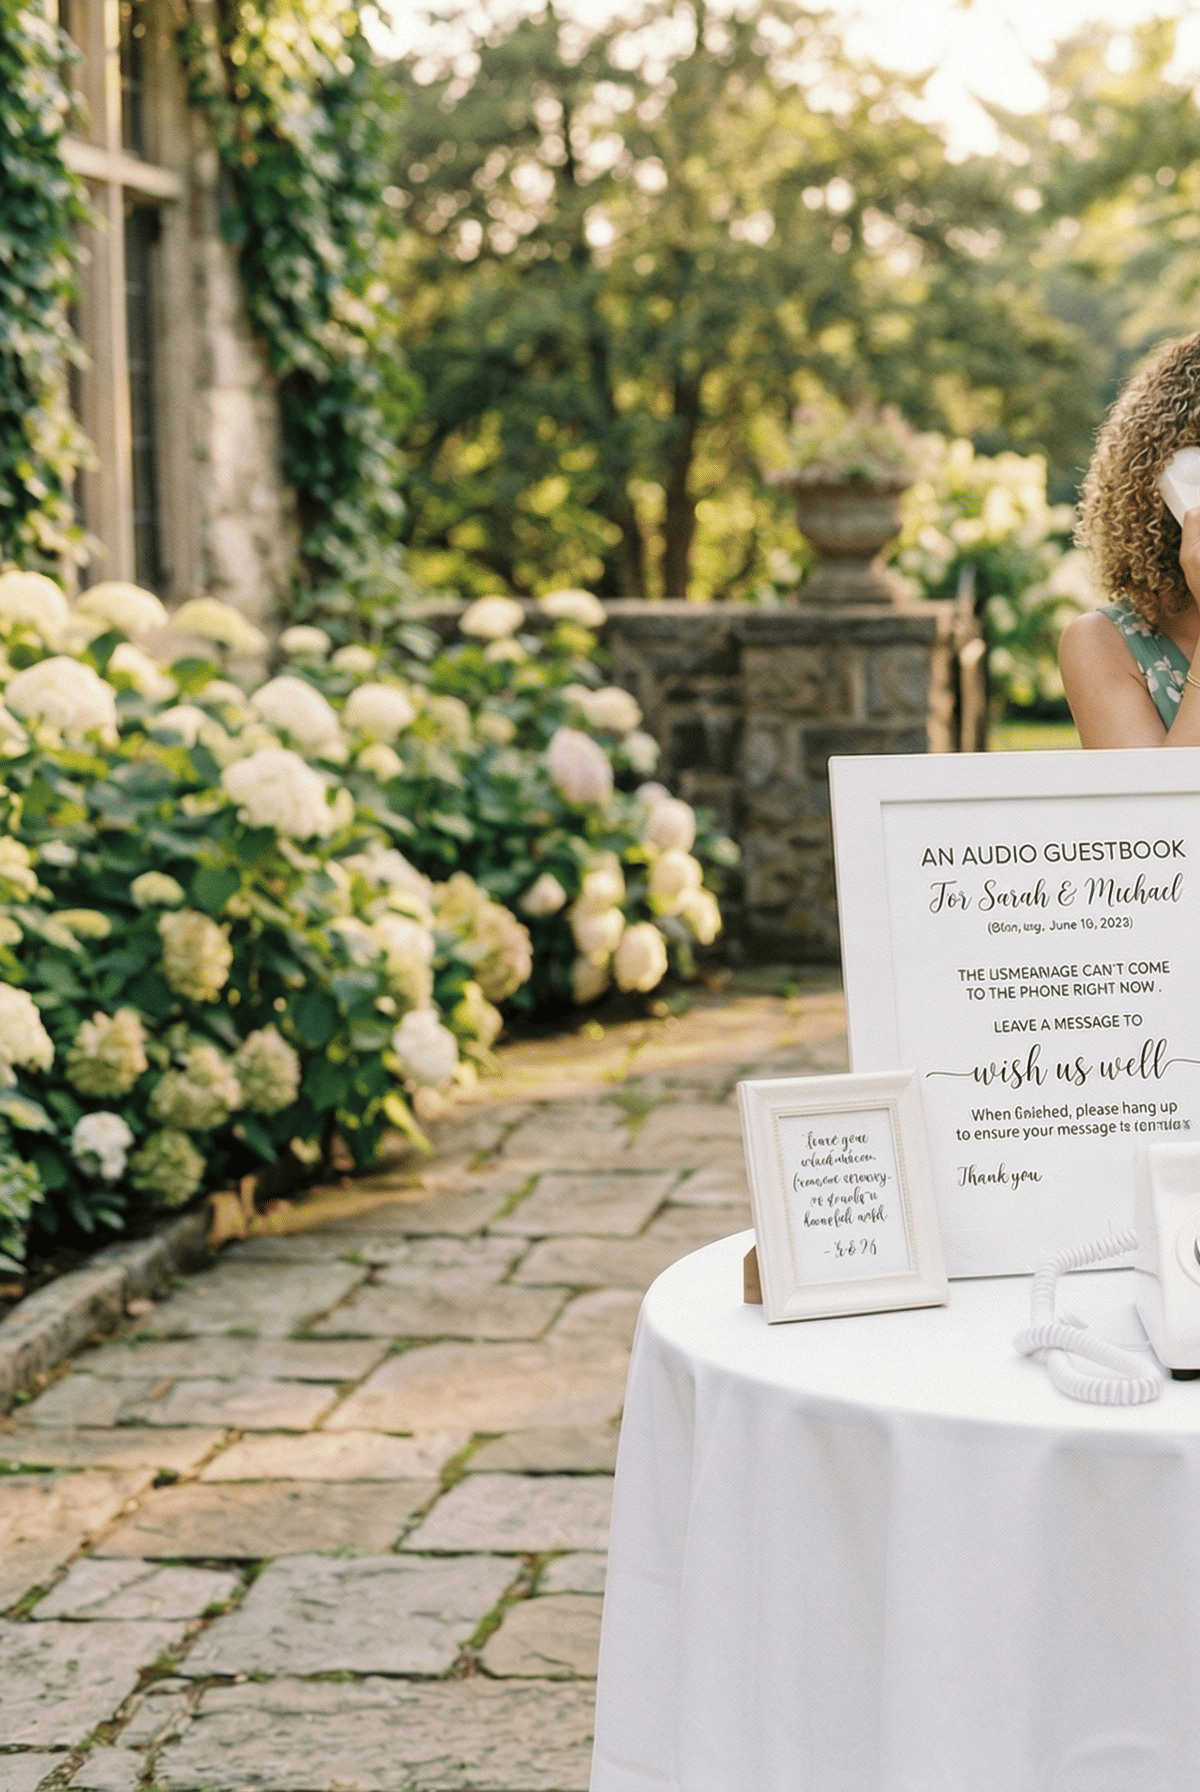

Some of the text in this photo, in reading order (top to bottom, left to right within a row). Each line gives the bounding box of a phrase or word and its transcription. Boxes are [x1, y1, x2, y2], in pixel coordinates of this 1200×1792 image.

[921, 839, 1186, 867] AN AUDIO GUESTBOOK
[978, 878, 1050, 912] Sarah
[1057, 880, 1078, 907] &
[1084, 872, 1184, 907] Michael
[1049, 920, 1077, 931] June
[958, 968, 985, 981] THE
[1083, 963, 1123, 977] CAN'T
[1128, 961, 1170, 975] COME
[966, 988, 985, 1000] TO
[989, 986, 1015, 999] THE
[1020, 984, 1069, 998] PHONE
[1073, 982, 1115, 996] RIGHT
[994, 1014, 1143, 1033] LEAVE A MESSAGE TO
[926, 1044, 1048, 1090] wish
[1056, 1056, 1094, 1086] us
[971, 1108, 1011, 1122] When
[1075, 1102, 1119, 1120] please
[1122, 1101, 1156, 1117] hang
[1160, 1102, 1178, 1116] up
[956, 1128, 971, 1141] to
[974, 1126, 1020, 1141] ensure
[1023, 1125, 1054, 1141] your
[1057, 1121, 1117, 1138] message
[957, 1162, 1043, 1191] Thank you
